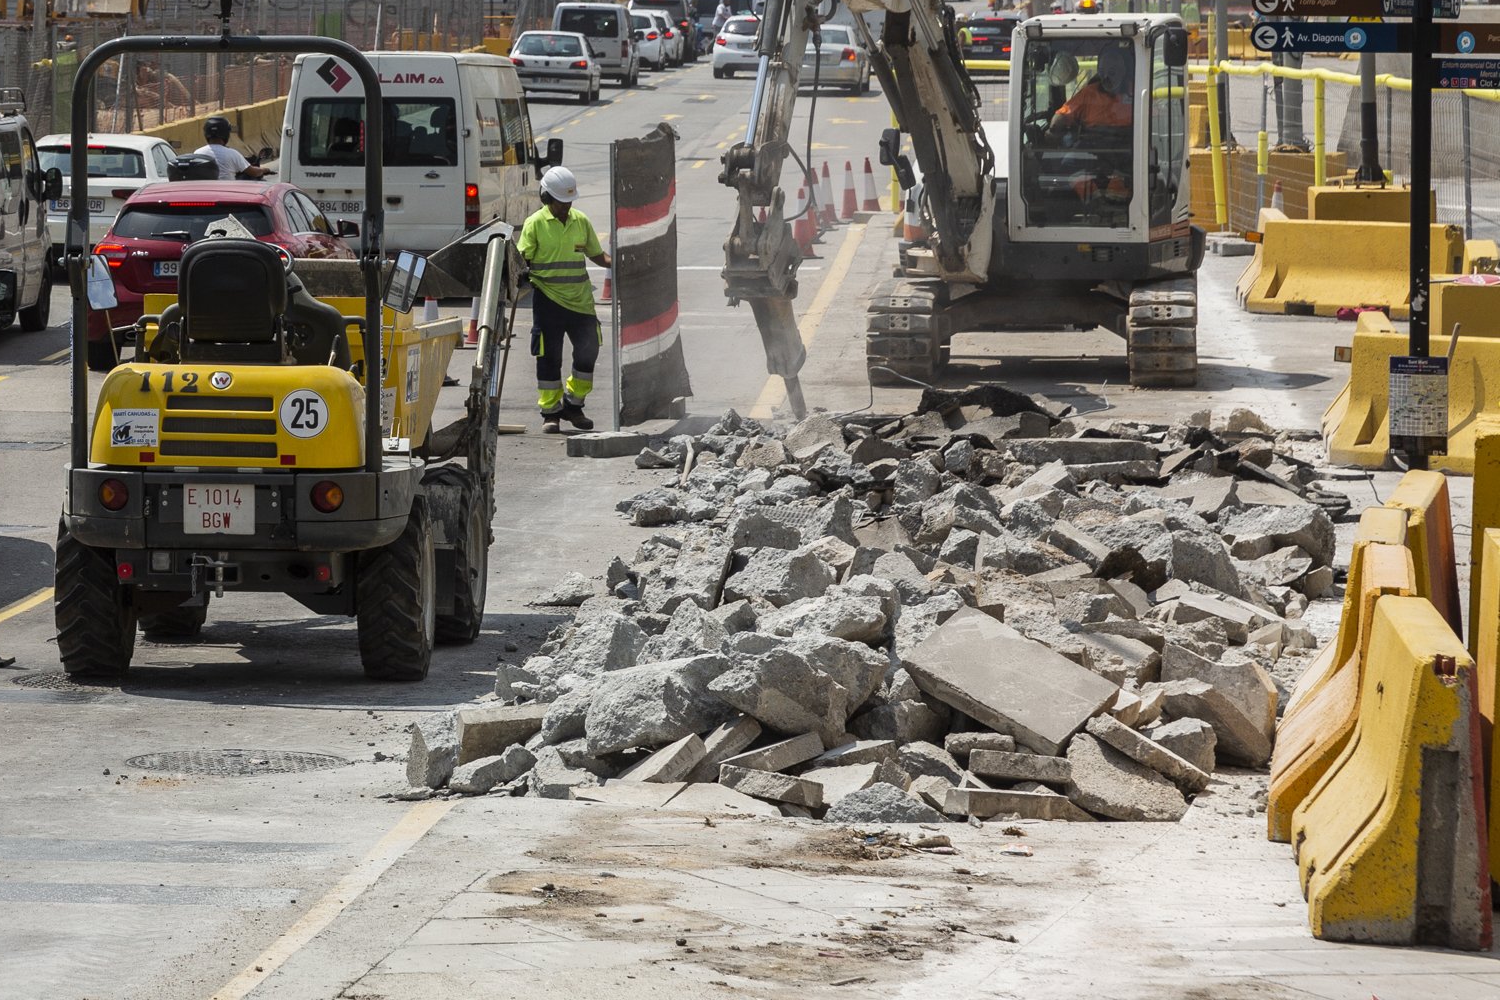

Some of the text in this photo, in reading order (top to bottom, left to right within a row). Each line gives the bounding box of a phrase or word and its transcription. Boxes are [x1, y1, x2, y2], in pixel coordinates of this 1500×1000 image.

[1297, 33, 1345, 44] Av. Diagona
[1480, 79, 1493, 88] Clot
[57, 200, 69, 209] 66
[163, 263, 177, 274] 99
[140, 371, 198, 393] 112
[291, 398, 319, 430] 25
[188, 488, 242, 506] E 1014
[202, 512, 231, 529] BGW
